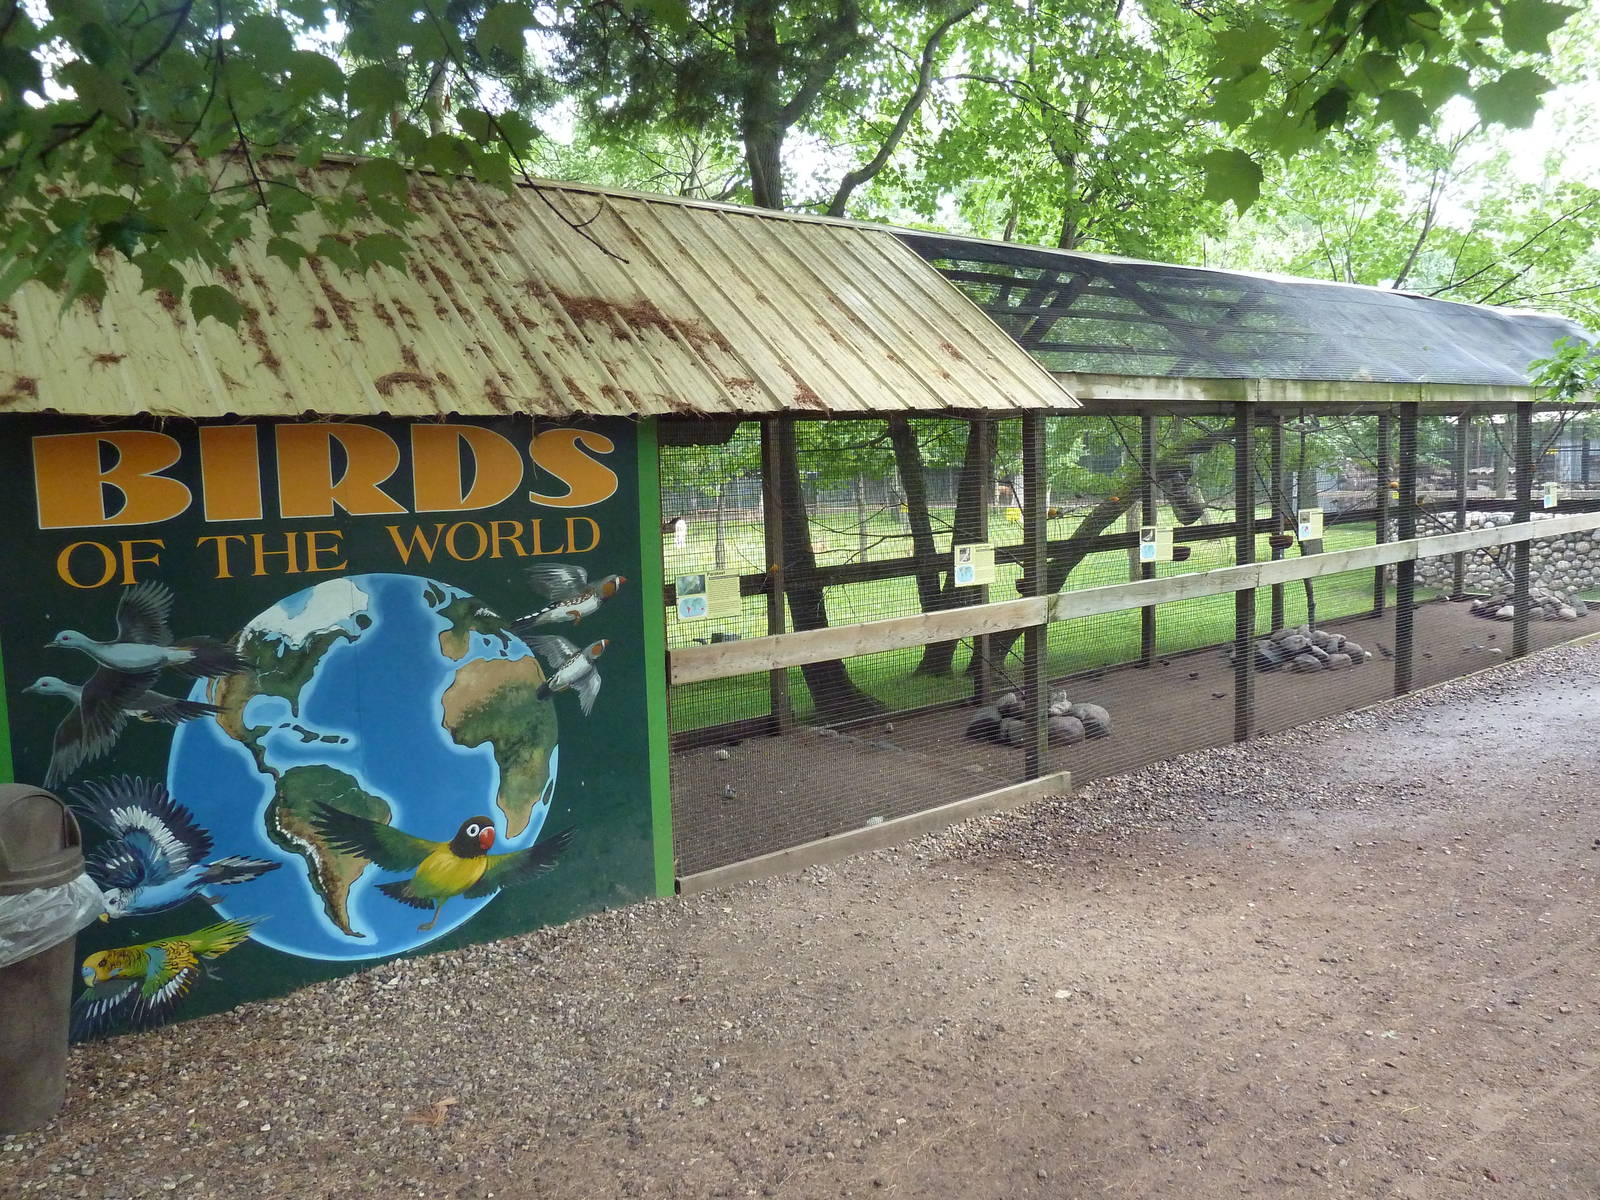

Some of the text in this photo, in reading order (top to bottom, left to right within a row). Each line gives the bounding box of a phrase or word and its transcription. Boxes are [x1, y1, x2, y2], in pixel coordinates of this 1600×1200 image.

[31, 423, 619, 530] BIRDS
[57, 516, 601, 589] OF THE WORLD
